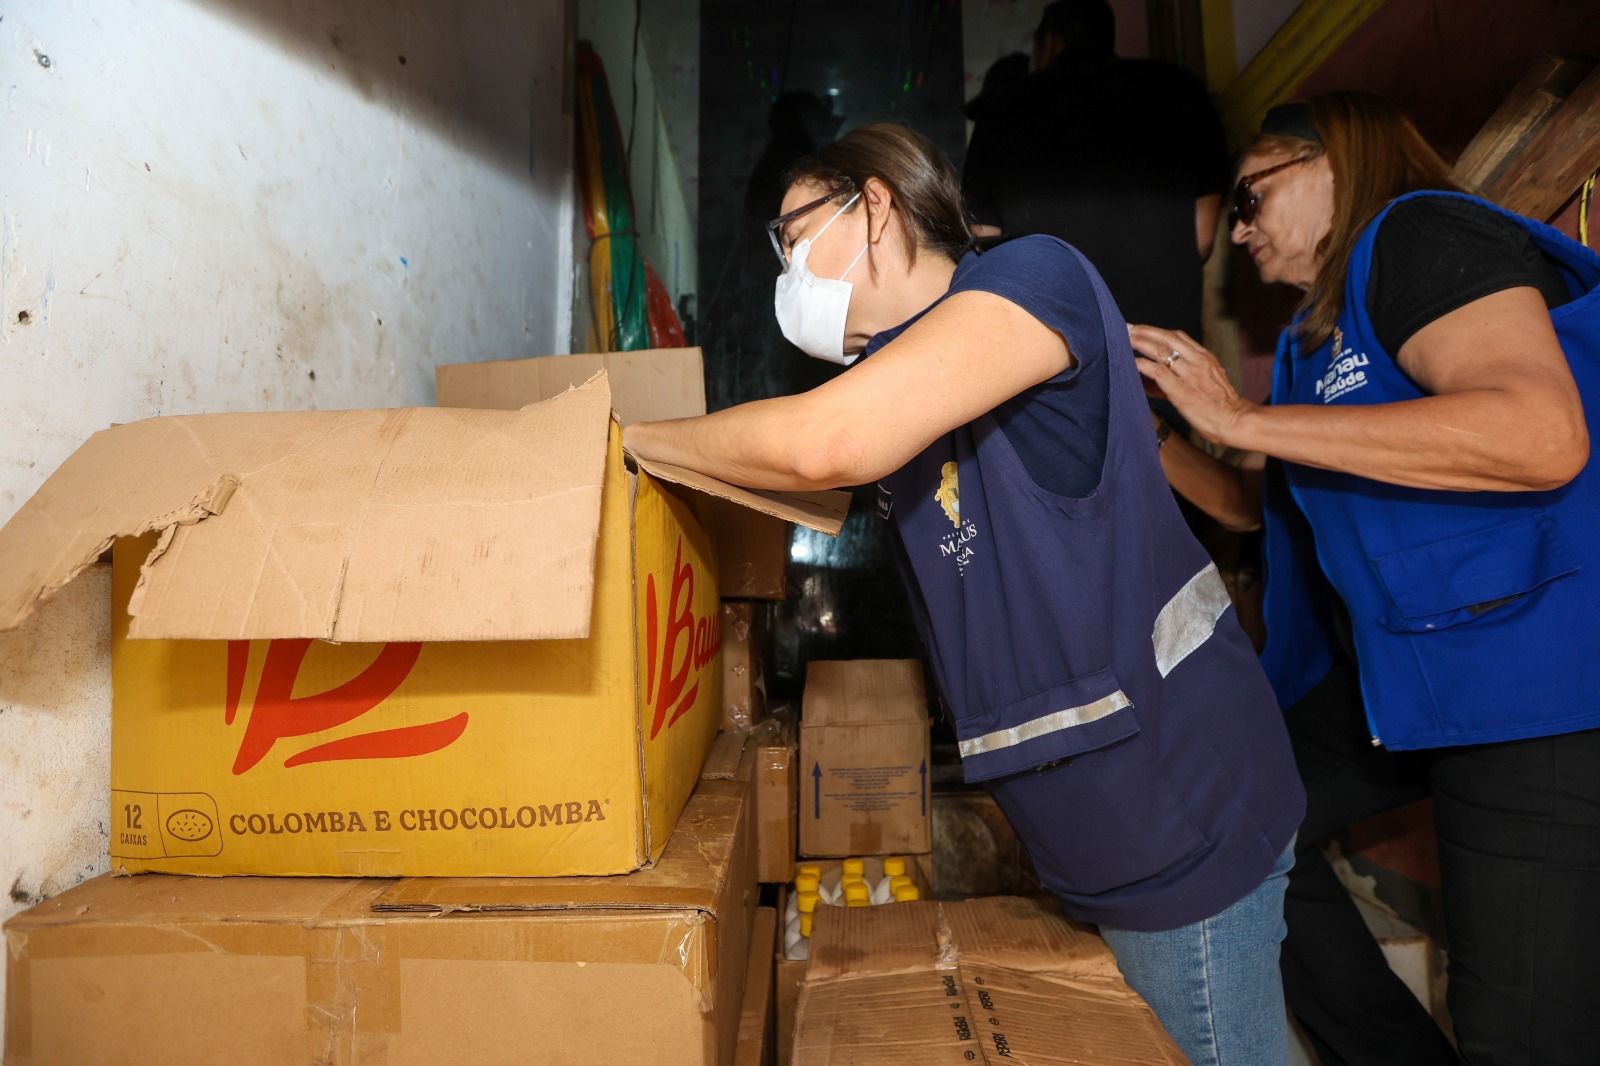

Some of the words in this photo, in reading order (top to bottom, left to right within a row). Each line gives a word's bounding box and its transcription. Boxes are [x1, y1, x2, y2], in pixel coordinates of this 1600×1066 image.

[124, 803, 143, 829] 12
[229, 811, 367, 836] COLOMBA
[373, 810, 392, 832] E
[399, 799, 606, 832] CHOCOLOMBA
[120, 832, 148, 847] CAIXAS
